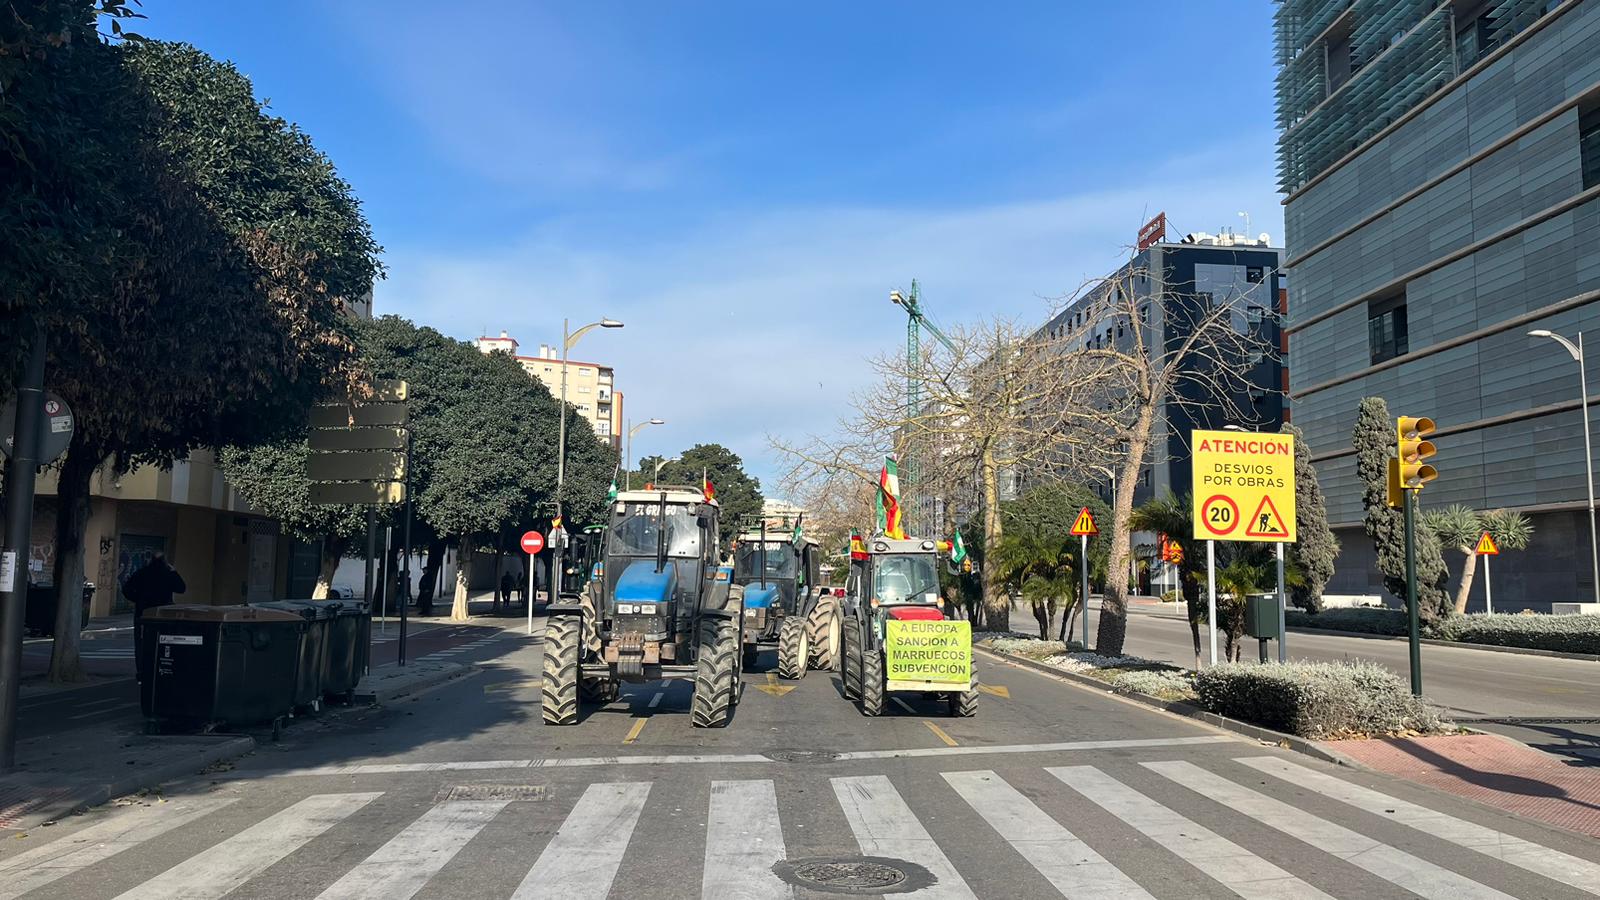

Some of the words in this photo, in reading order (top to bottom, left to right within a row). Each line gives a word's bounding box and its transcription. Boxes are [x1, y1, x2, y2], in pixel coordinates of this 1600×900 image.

[1214, 463, 1273, 475] DESVIOS
[1204, 475, 1232, 486] POR
[1237, 476, 1284, 488] OBRAS
[645, 504, 677, 516] GRIGO
[1210, 507, 1230, 522] 20
[900, 624, 908, 633] A
[911, 623, 958, 633] EUROPA
[951, 638, 959, 646] A
[893, 650, 966, 660] MARRUECOS
[892, 662, 966, 674] SUBVENCIÓN
